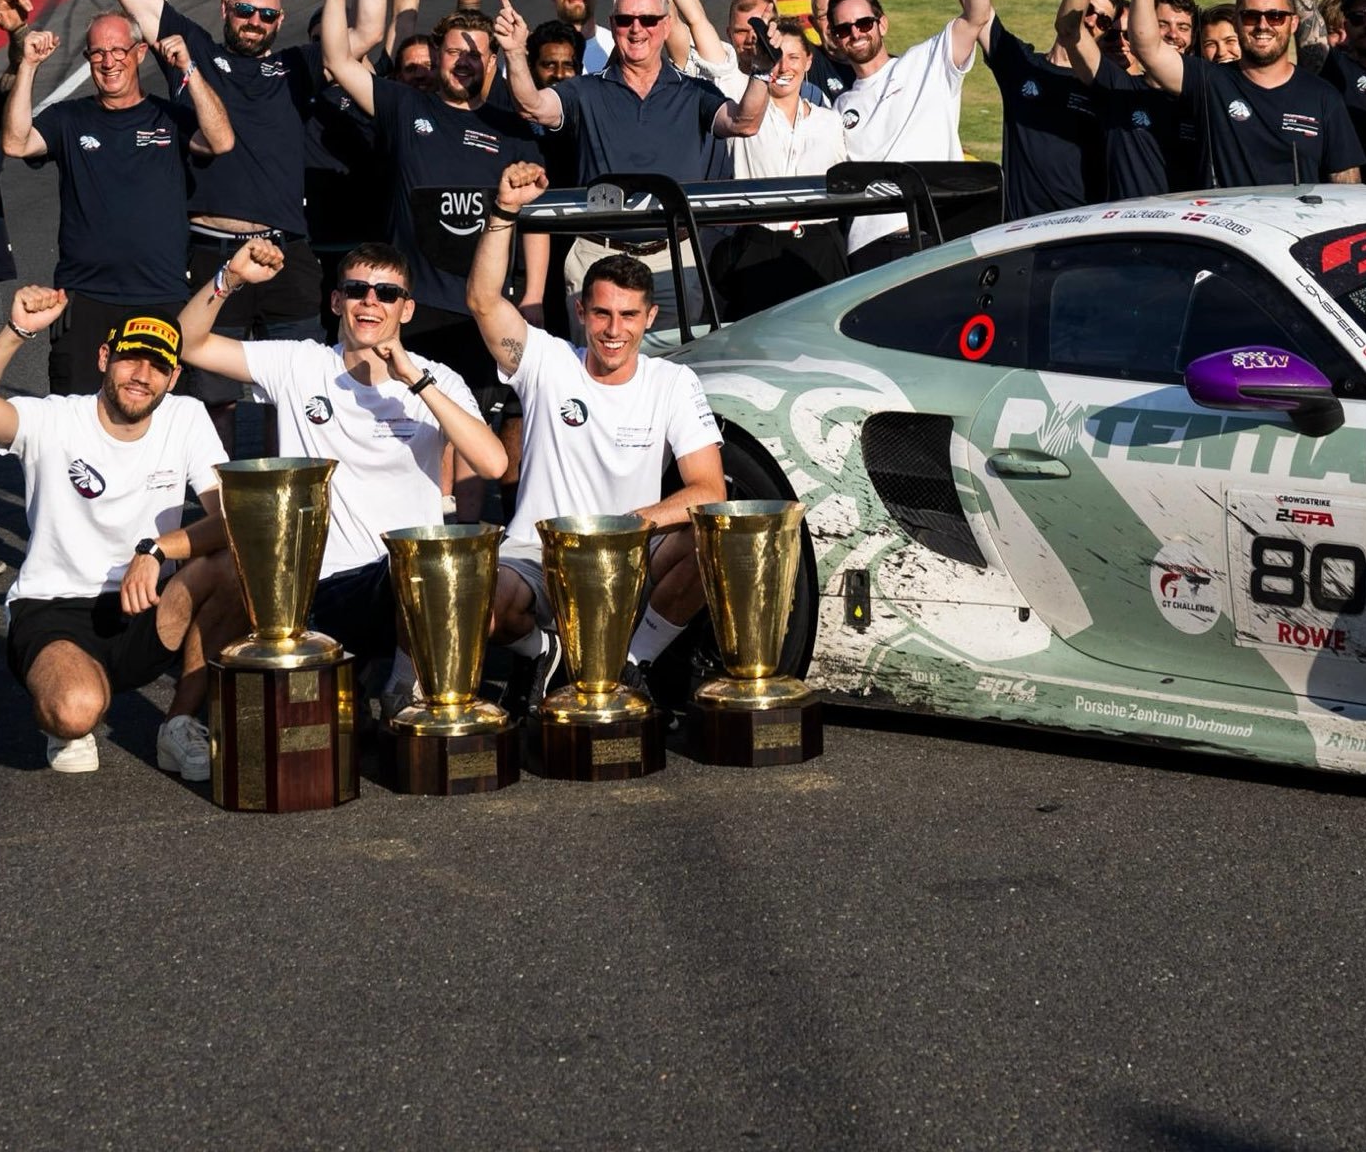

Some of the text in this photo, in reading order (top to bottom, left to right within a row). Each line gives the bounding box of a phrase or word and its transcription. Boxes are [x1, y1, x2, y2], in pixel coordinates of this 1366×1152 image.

[441, 192, 483, 216] aws
[1296, 275, 1366, 348] LIONSPEED
[128, 319, 177, 344] PIRELLI
[1243, 353, 1290, 369] KW
[1278, 495, 1331, 507] CROWDSTRIKE
[1162, 600, 1171, 608] GT
[1278, 622, 1346, 651] ROWE
[1075, 695, 1253, 738] Porsche Zentrum Dortmund
